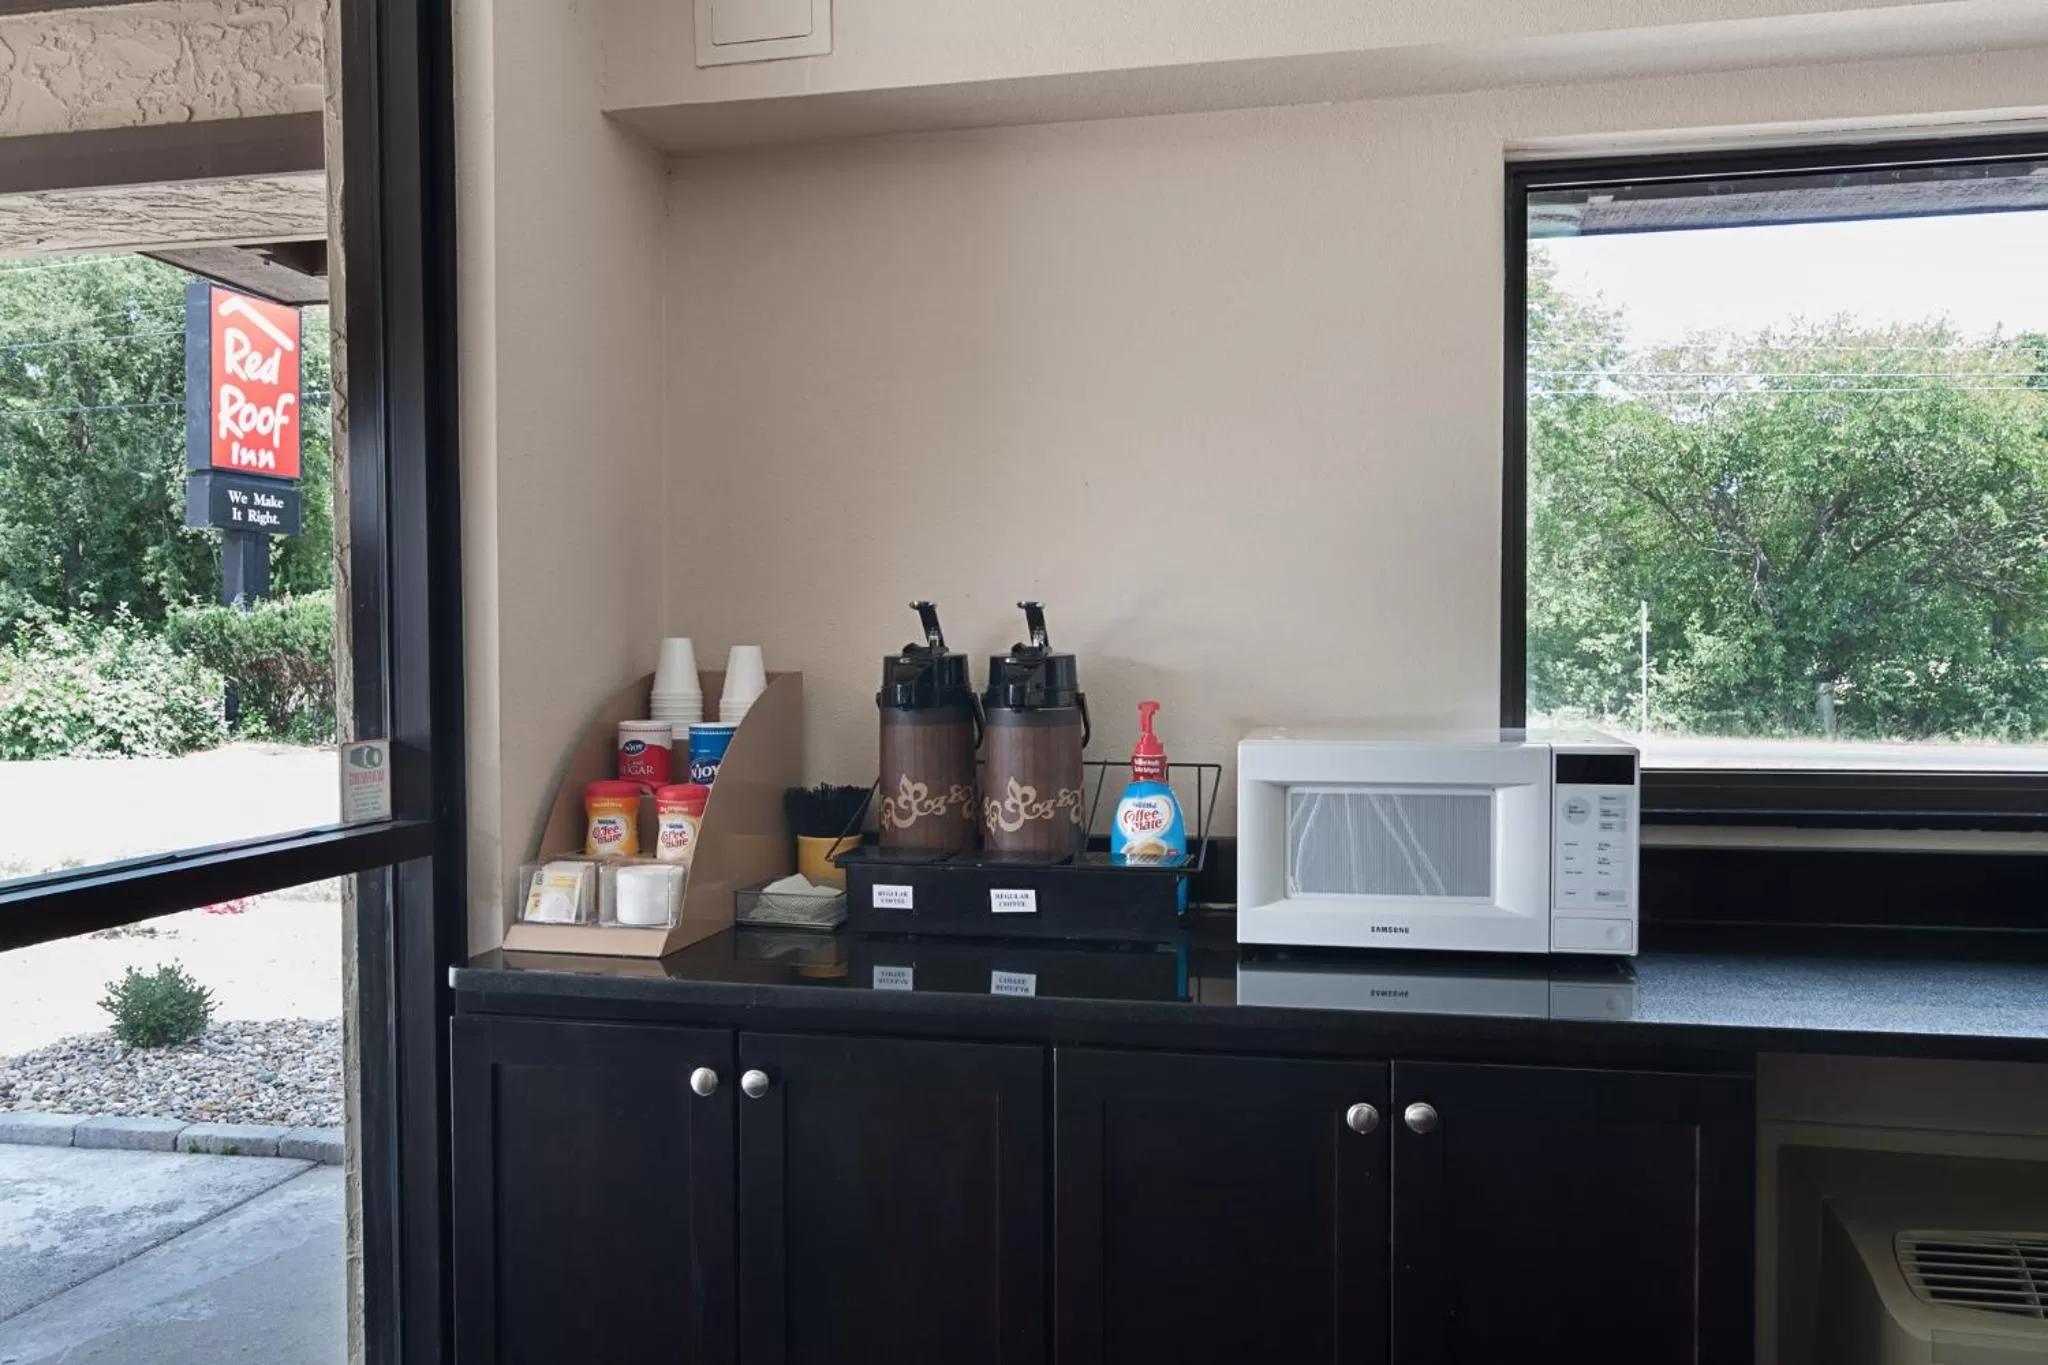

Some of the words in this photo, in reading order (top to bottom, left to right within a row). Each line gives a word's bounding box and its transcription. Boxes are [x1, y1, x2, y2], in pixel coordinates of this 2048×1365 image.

[224, 327, 282, 385] Red
[218, 384, 295, 448] Roof
[231, 441, 275, 469] Inn
[228, 489, 248, 505] We
[253, 492, 284, 509] Make
[232, 507, 243, 521] It
[248, 508, 280, 526] Right.
[1123, 808, 1160, 824] Coffee
[1371, 926, 1410, 934] SAMSUNG
